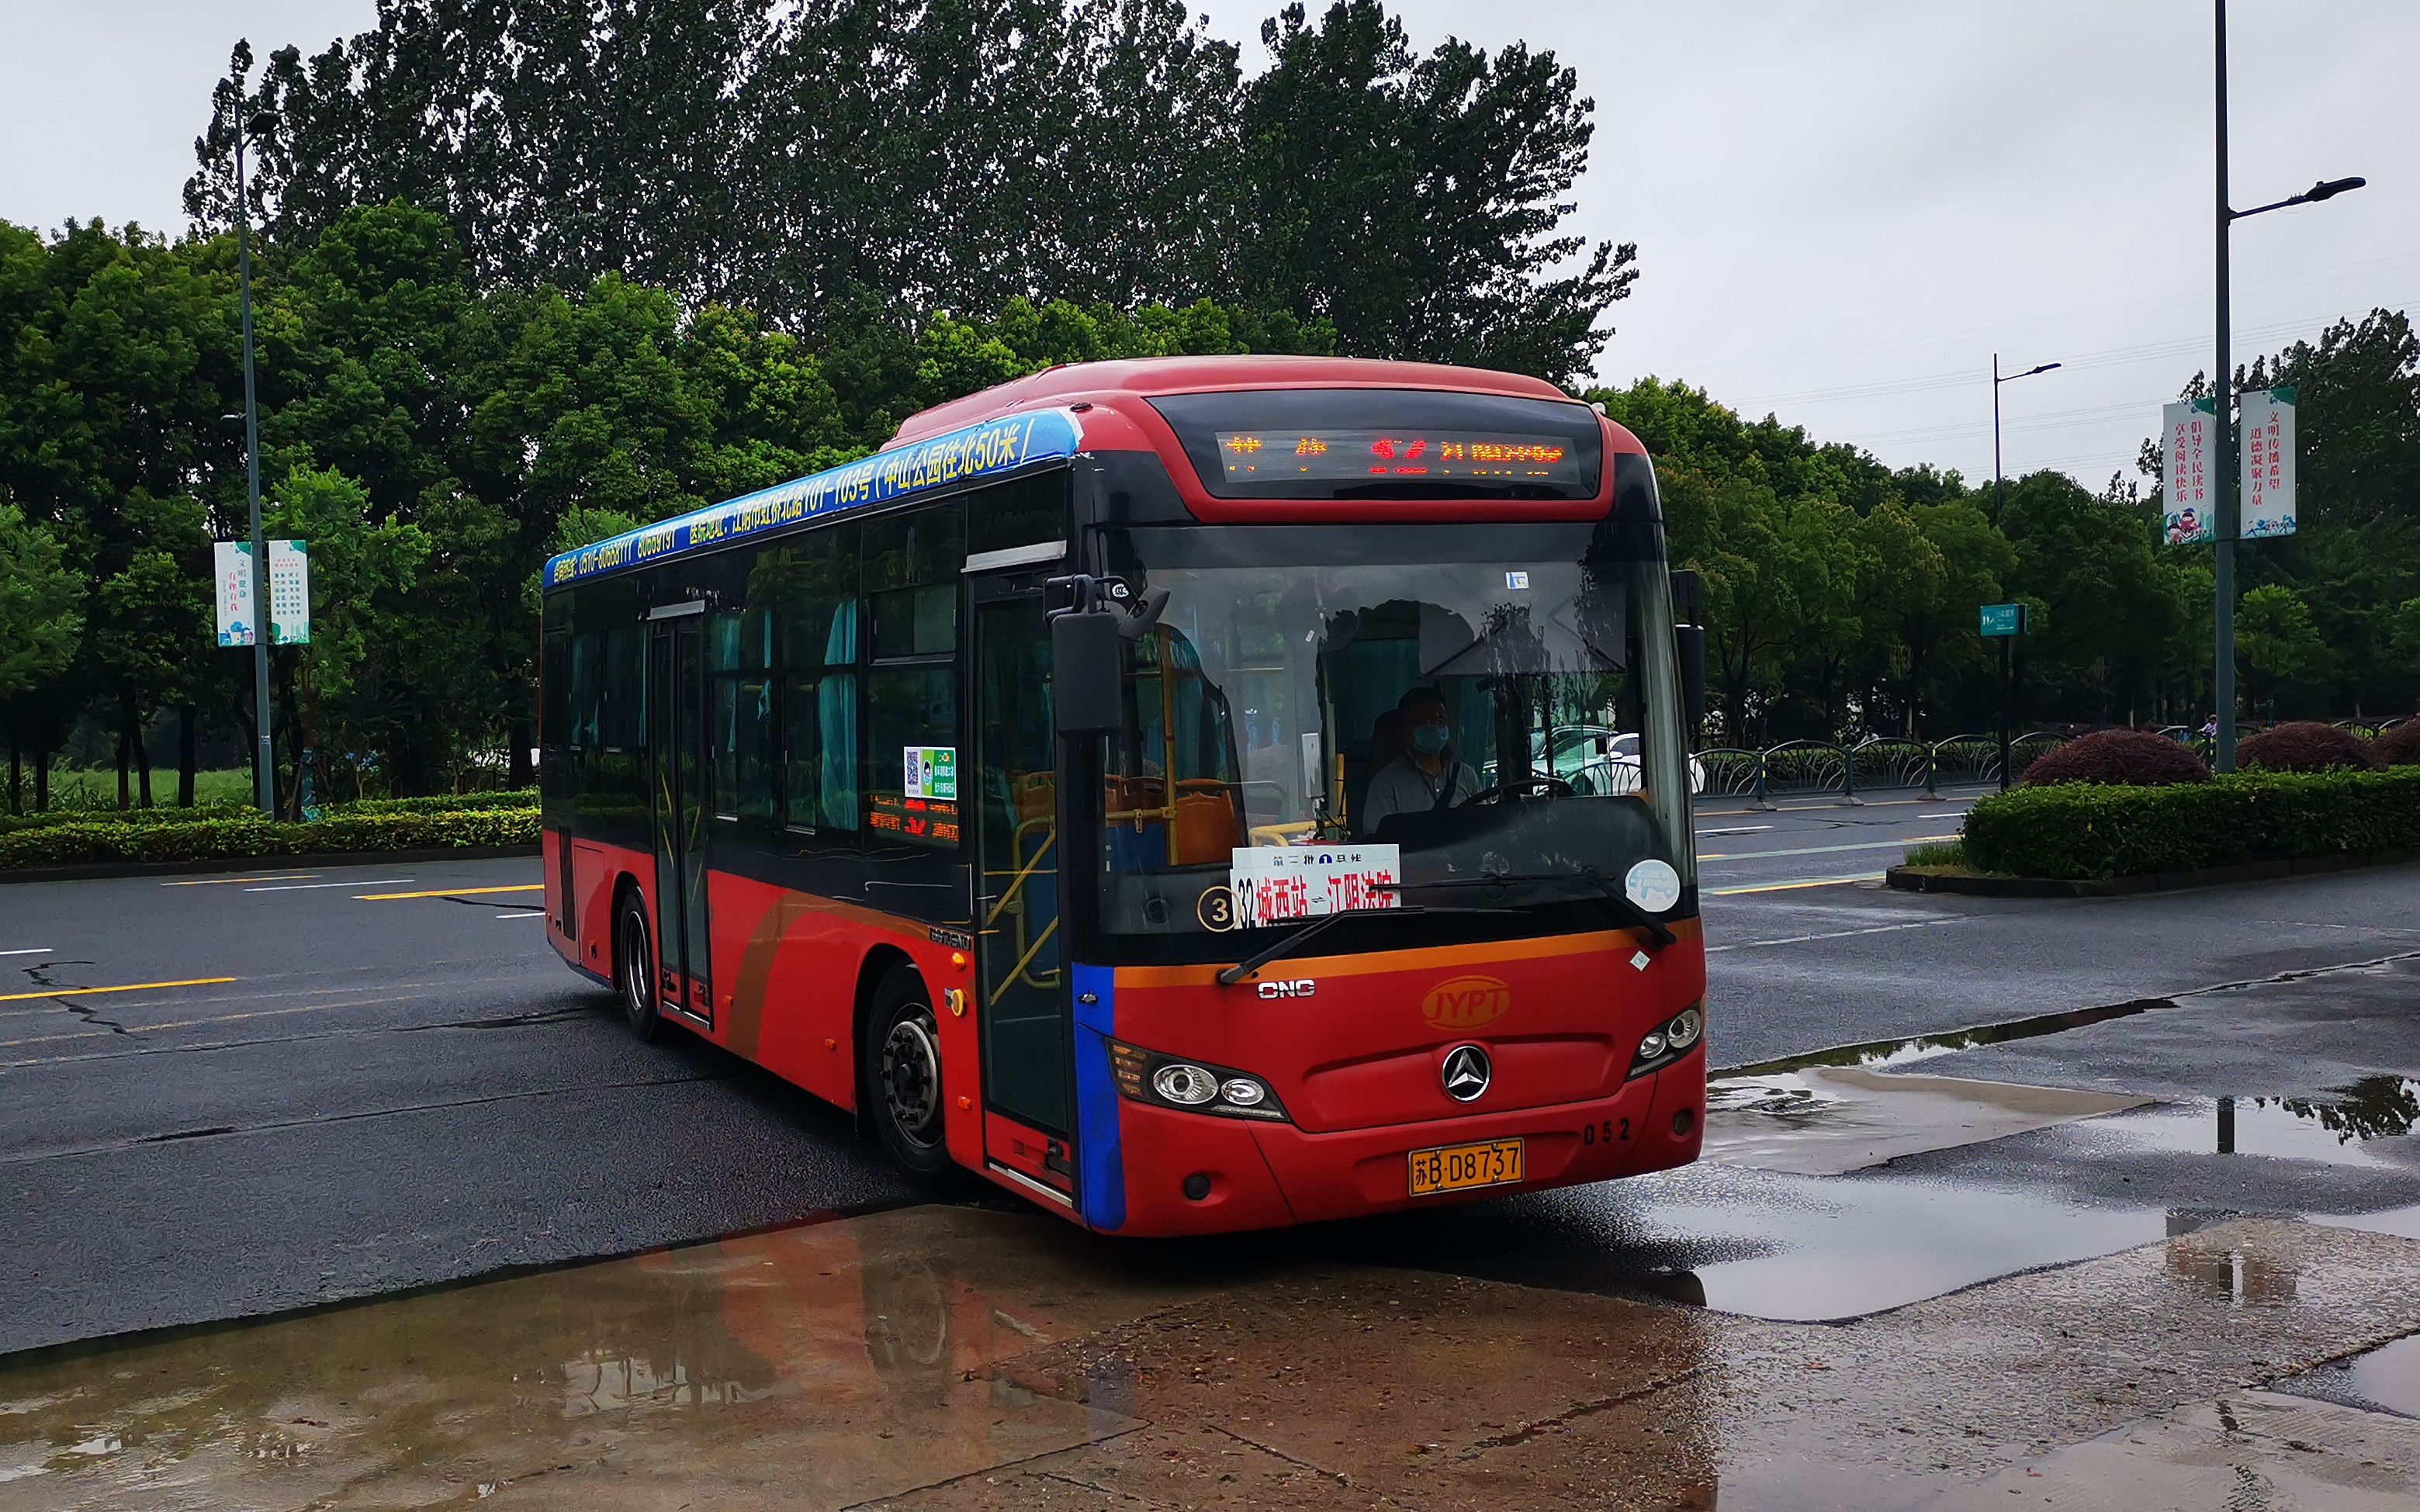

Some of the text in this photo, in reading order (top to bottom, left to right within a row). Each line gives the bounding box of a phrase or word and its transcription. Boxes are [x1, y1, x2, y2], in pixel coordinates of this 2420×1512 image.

[2174, 422, 2187, 503] 享受阅读快乐
[2190, 420, 2204, 501] 倡导全民读书
[2249, 427, 2263, 506] 道德凝聚力量
[2267, 410, 2280, 490] 文明传播希望
[1212, 898, 1228, 922] 3
[1238, 878, 1256, 929] 32
